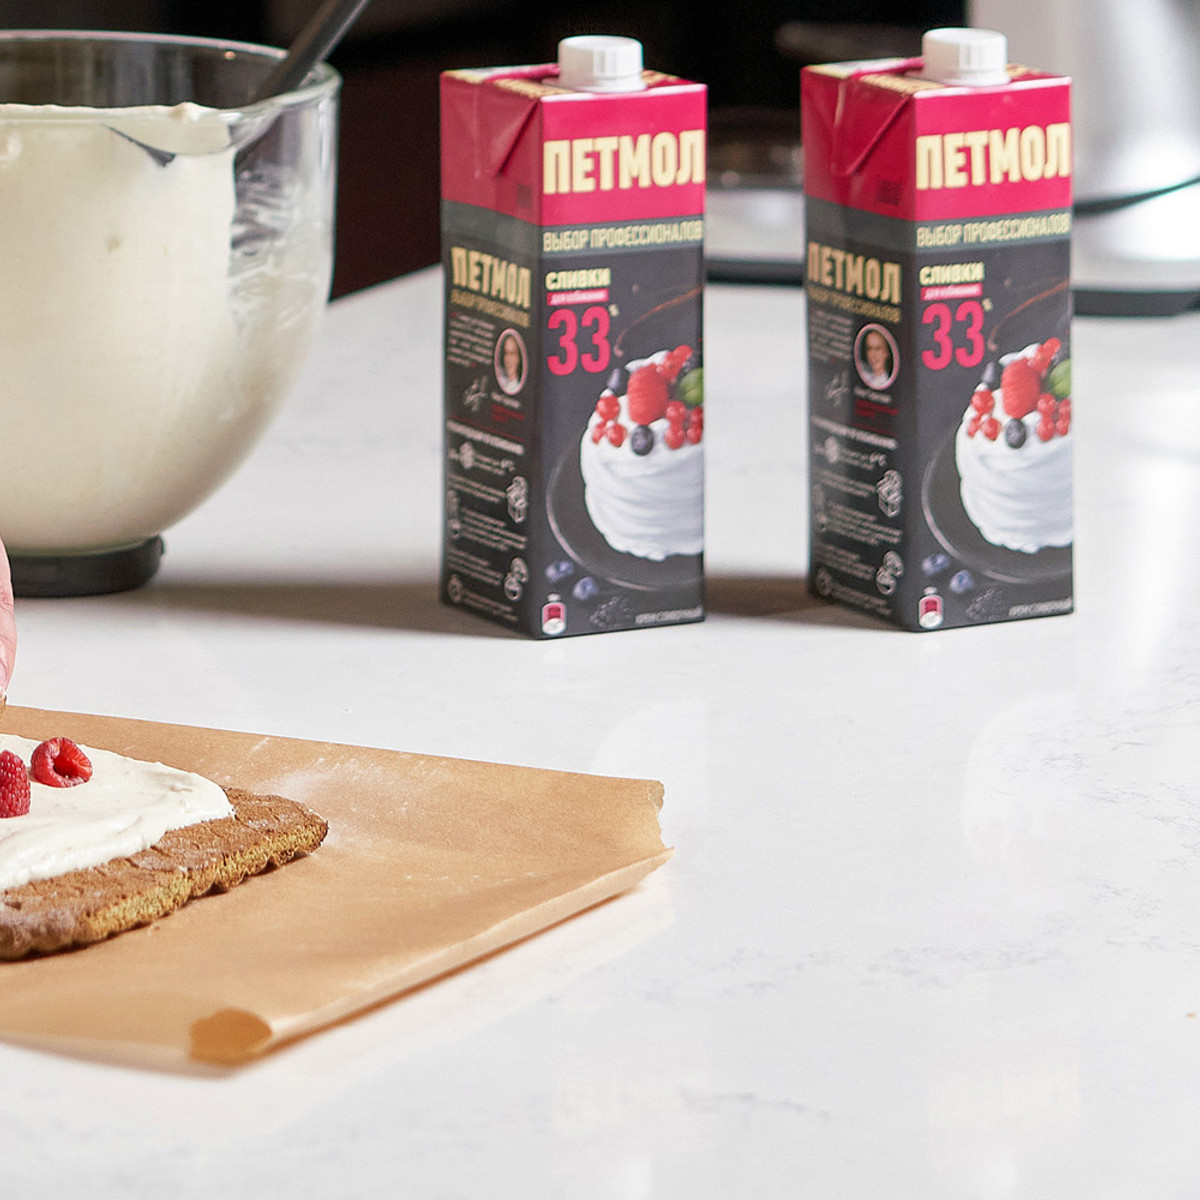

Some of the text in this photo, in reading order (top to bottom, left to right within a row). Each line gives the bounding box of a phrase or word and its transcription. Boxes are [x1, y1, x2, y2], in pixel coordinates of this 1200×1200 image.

[543, 129, 705, 195] ПЕТМОЛ
[916, 122, 1071, 190] ПЕТМОЛ
[543, 219, 704, 252] ВЫБОР ПРОФЕССИОНАЛОВ
[916, 224, 962, 248] ВЫБОР
[451, 246, 531, 309] ПЕТМОЛ
[545, 267, 611, 291] СЛИВКИ
[807, 241, 901, 305] ПЕТМОЛ
[919, 261, 985, 286] СЛИВКИ
